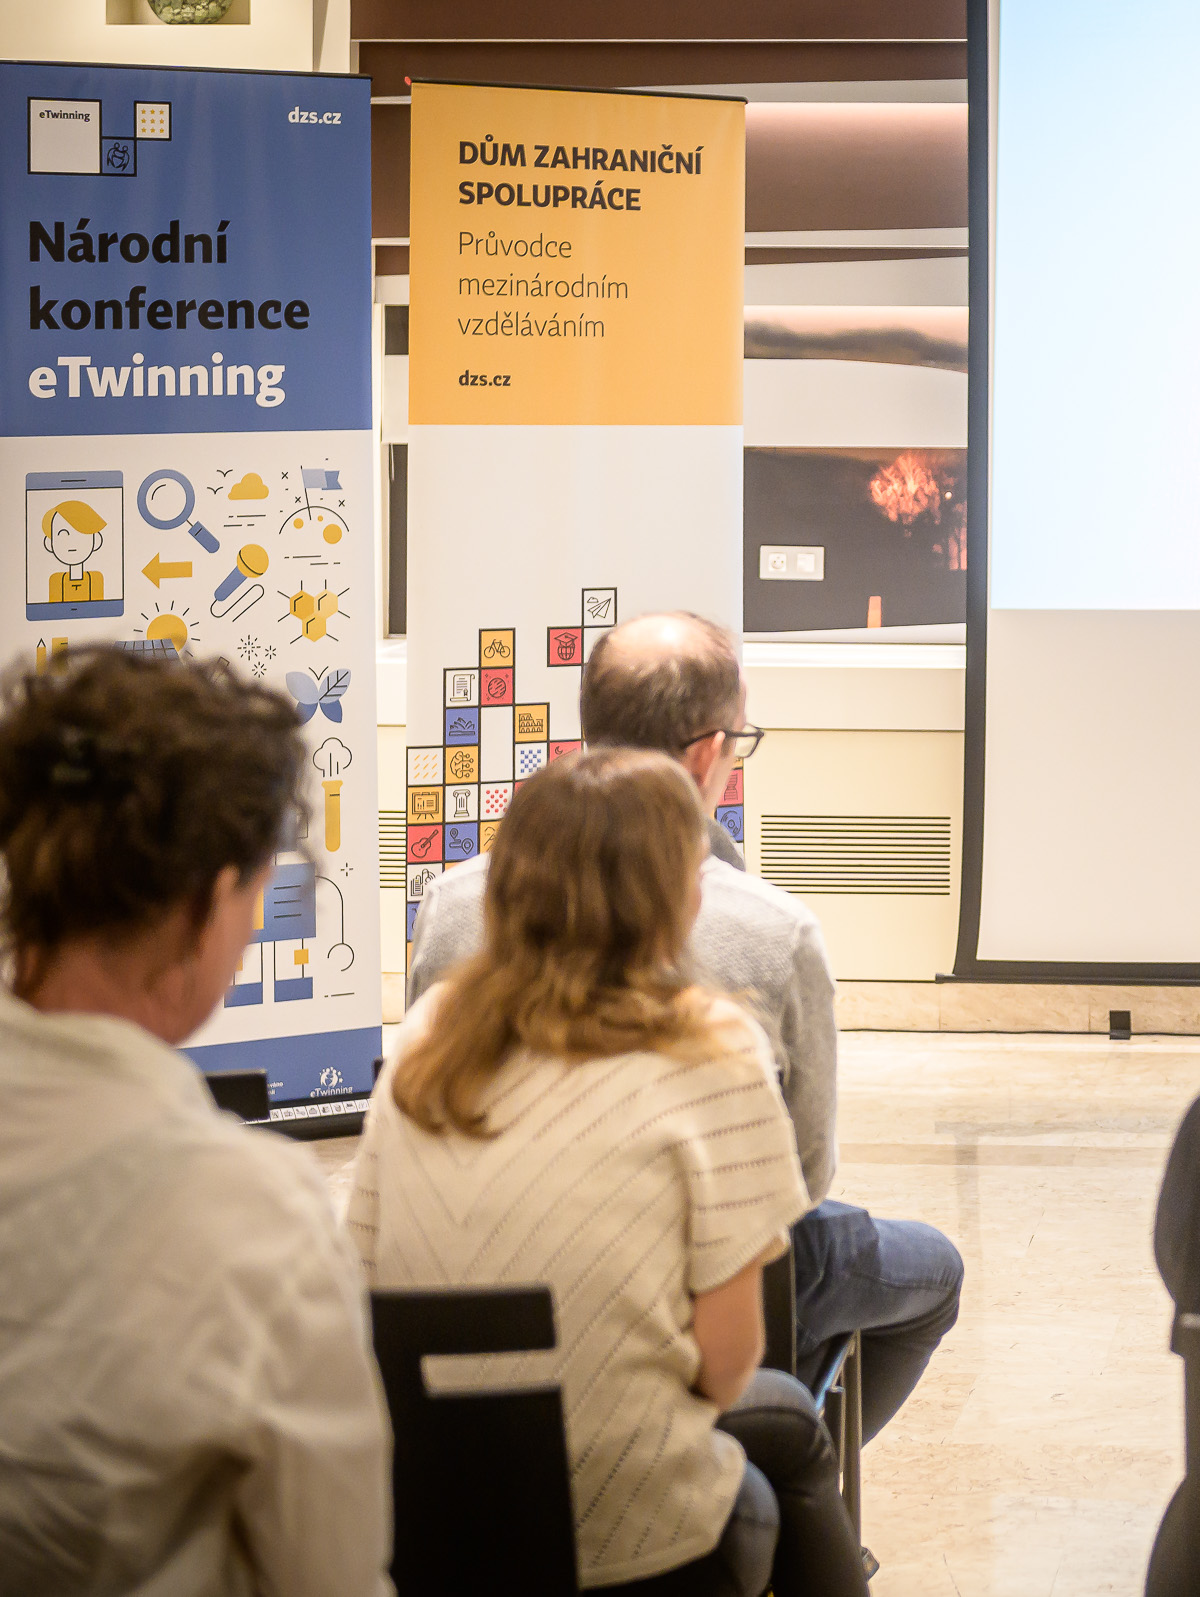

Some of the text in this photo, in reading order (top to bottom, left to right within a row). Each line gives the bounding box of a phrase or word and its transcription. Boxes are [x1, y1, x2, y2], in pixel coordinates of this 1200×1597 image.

[39, 109, 91, 123] eTwinning
[287, 106, 342, 125] dzs.cz
[458, 134, 705, 175] DŮM ZAHRANIČNÍ
[458, 179, 642, 212] SPOLUPRÁCE
[28, 217, 232, 264] Národní
[458, 230, 573, 259] Průvodce
[458, 272, 629, 299] mezinárodním
[28, 285, 311, 331] konference
[457, 310, 606, 338] vzděláváním
[27, 351, 287, 408] eTwinning
[458, 369, 512, 387] dzs.cz
[309, 1086, 353, 1098] eTwinning
